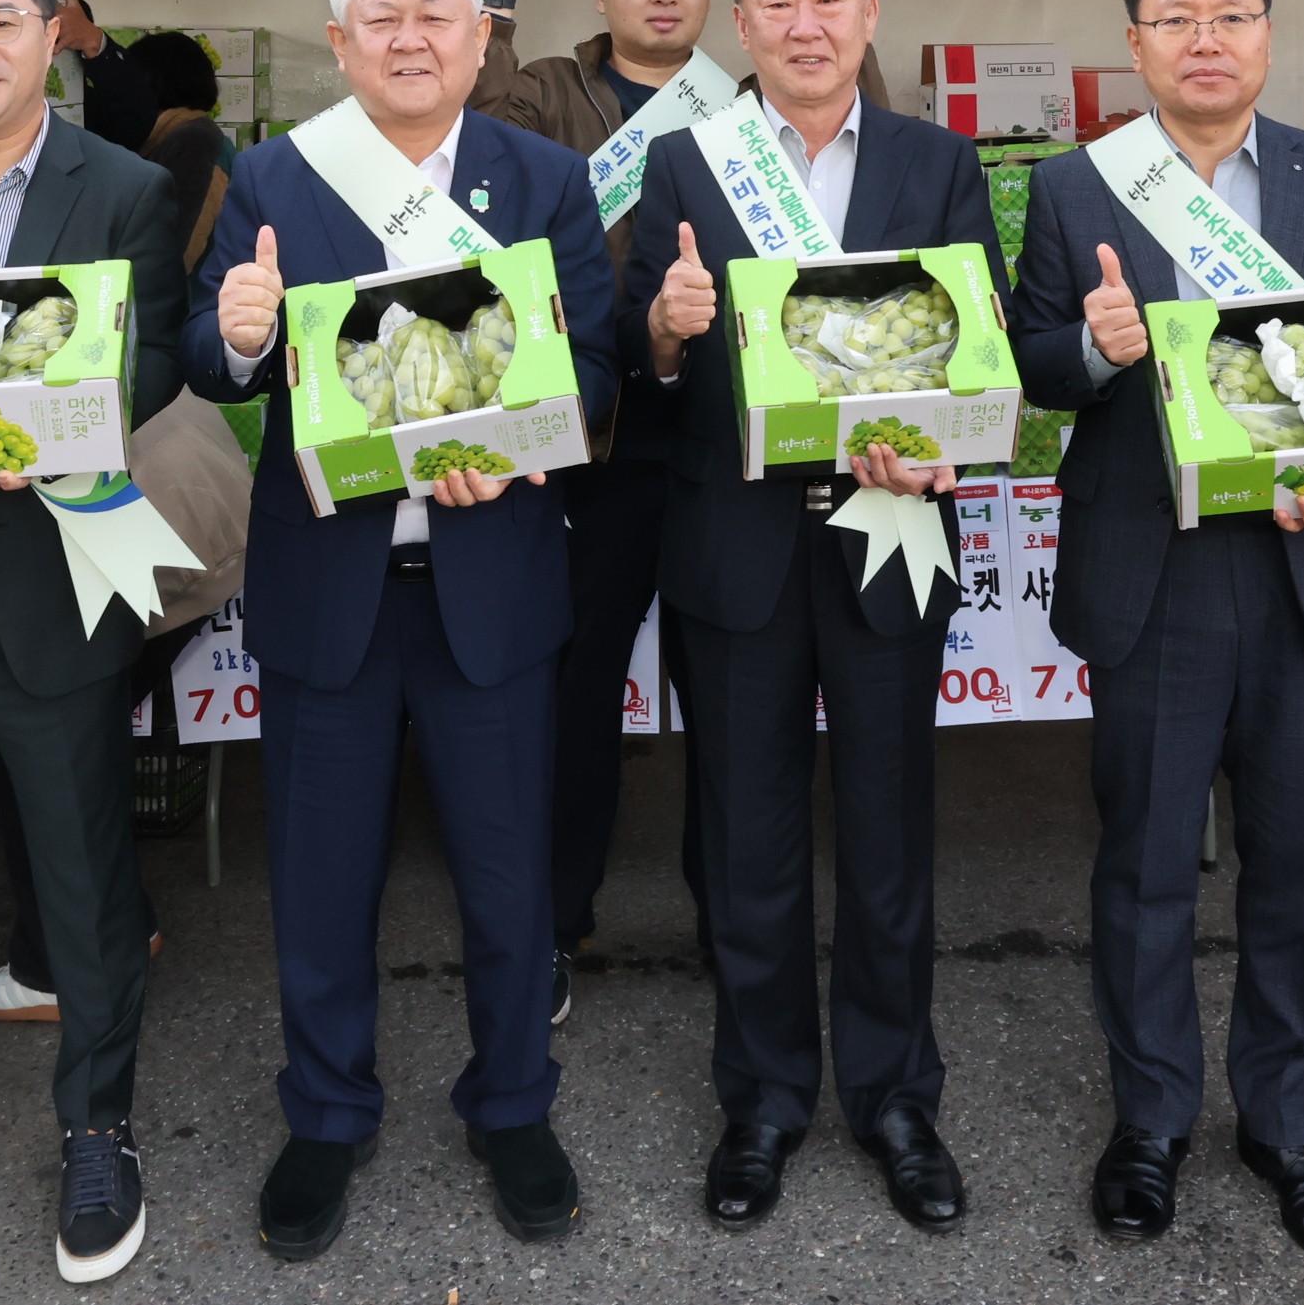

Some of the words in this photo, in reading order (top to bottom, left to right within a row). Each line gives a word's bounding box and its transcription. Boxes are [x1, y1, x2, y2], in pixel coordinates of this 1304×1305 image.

[1060, 97, 1071, 127] 고구마
[1128, 155, 1170, 202] 반딧불
[384, 189, 430, 236] 반딧불
[723, 158, 789, 251] 소비촉진
[87, 395, 106, 426] 샤인
[551, 411, 570, 434] 샤인
[988, 402, 1007, 426] 샤인
[965, 553, 996, 564] 국내산
